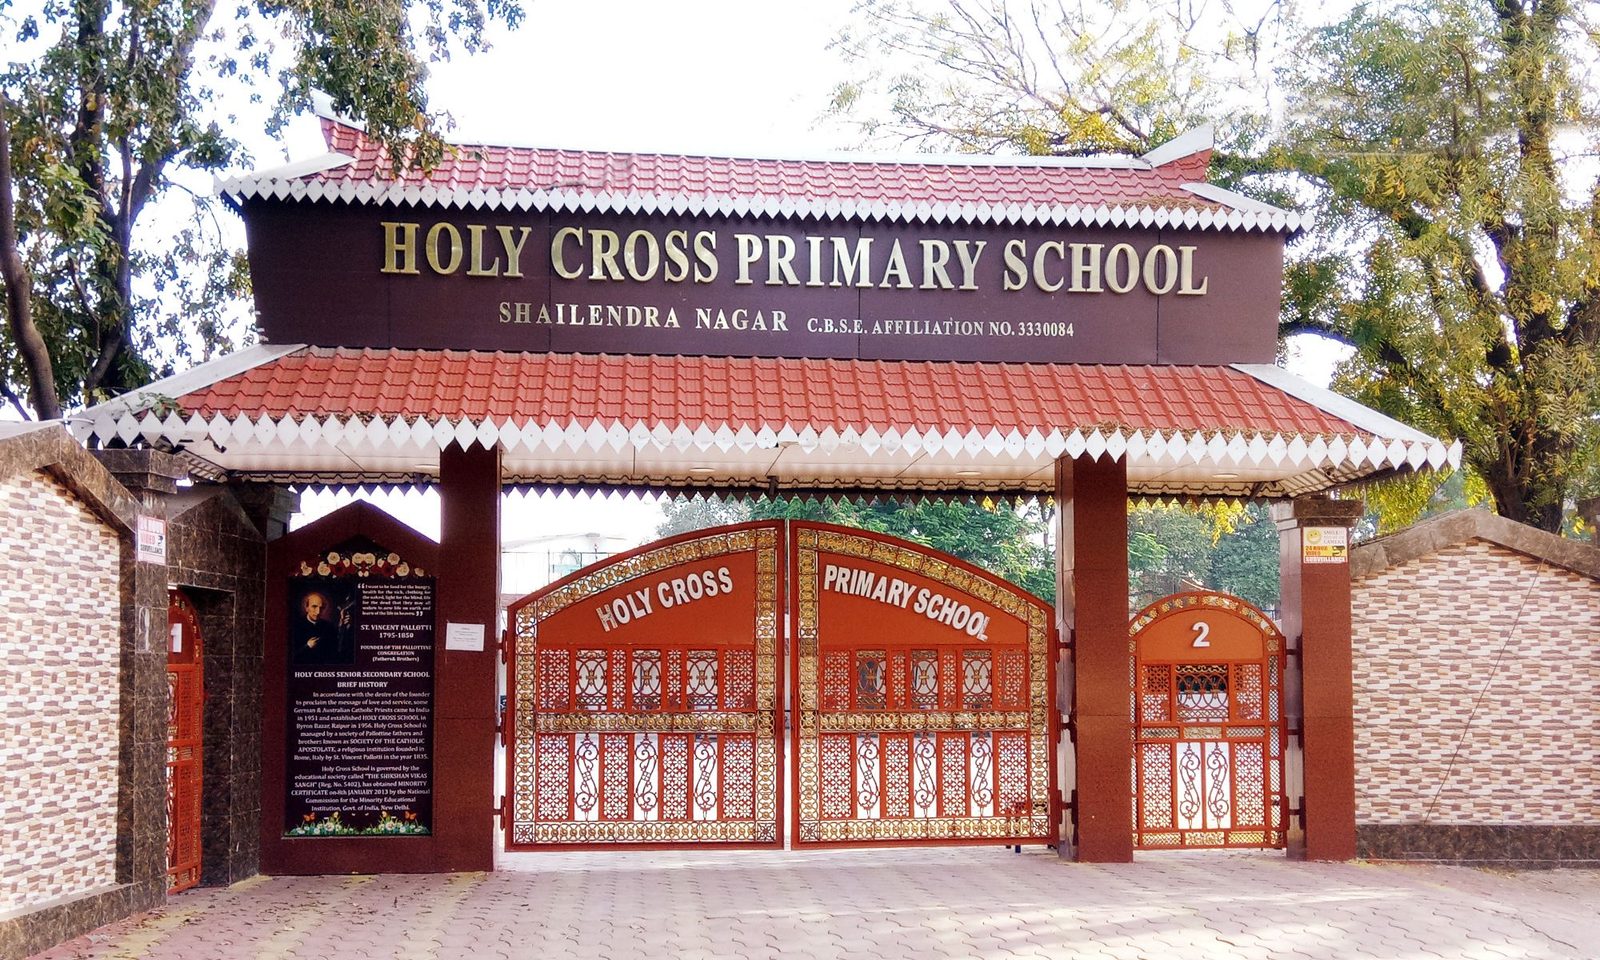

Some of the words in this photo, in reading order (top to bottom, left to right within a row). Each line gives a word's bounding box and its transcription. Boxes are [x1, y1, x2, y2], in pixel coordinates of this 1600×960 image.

[381, 222, 532, 278] HOLY
[550, 227, 719, 284] CROSS
[734, 233, 987, 291] PRIMARY
[1003, 239, 1209, 296] SCHOOL
[499, 302, 681, 329] SHAILENDRA
[695, 308, 789, 333] NAGAR
[807, 318, 868, 335] C.B.S.E.
[872, 317, 984, 337] AFFILIATION
[989, 320, 1016, 338] NO.
[1018, 321, 1075, 338] 3330084
[595, 587, 653, 632] HOLY
[656, 566, 733, 610] CROSS
[823, 564, 917, 615] PRIMARY
[912, 588, 991, 641] SCHOOL
[170, 623, 182, 652] 1
[1192, 622, 1210, 648] 2
